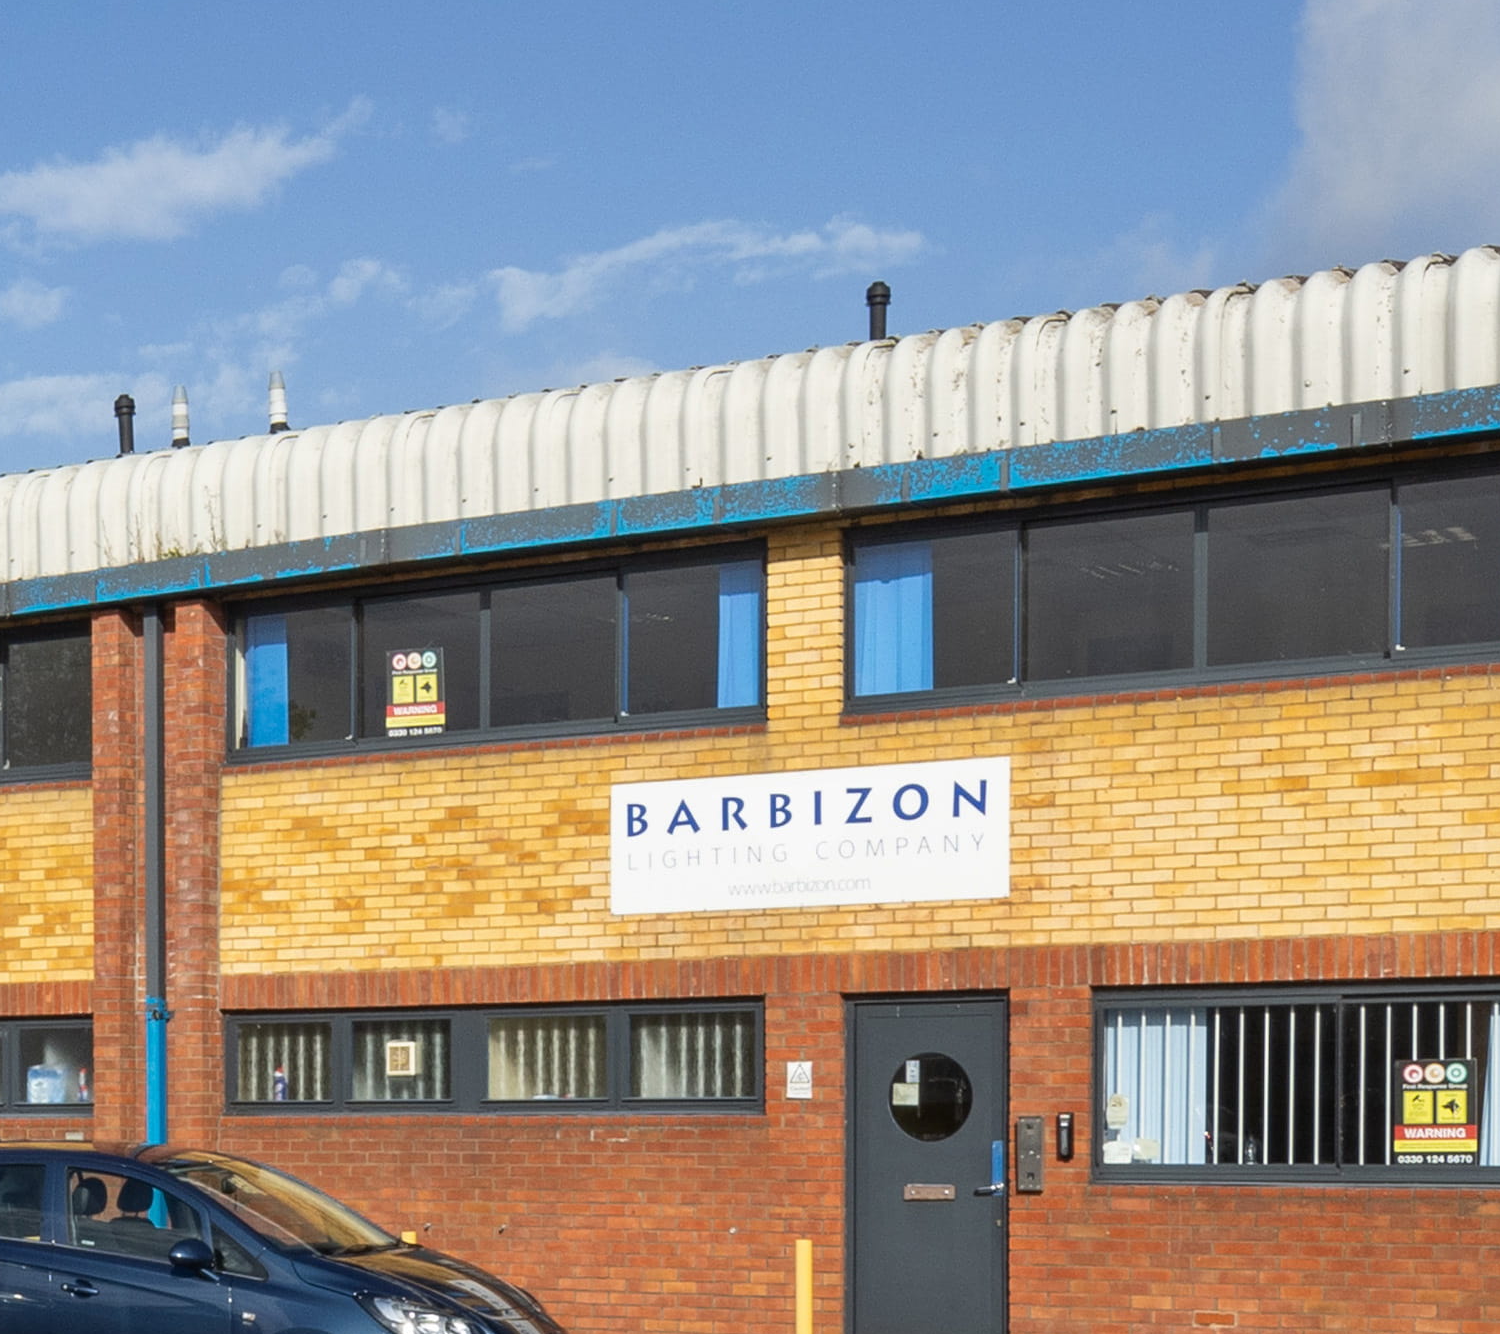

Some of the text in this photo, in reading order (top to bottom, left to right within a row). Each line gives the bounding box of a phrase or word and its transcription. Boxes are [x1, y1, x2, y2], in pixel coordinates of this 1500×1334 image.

[393, 704, 438, 715] WARNING
[626, 779, 987, 837] BARBIZON
[628, 833, 985, 870] LIGHTING COMPANY
[728, 876, 871, 896] www.barbizon.com
[1403, 1127, 1467, 1139] WARNING
[1397, 1154, 1473, 1164] 0330 124 5670
